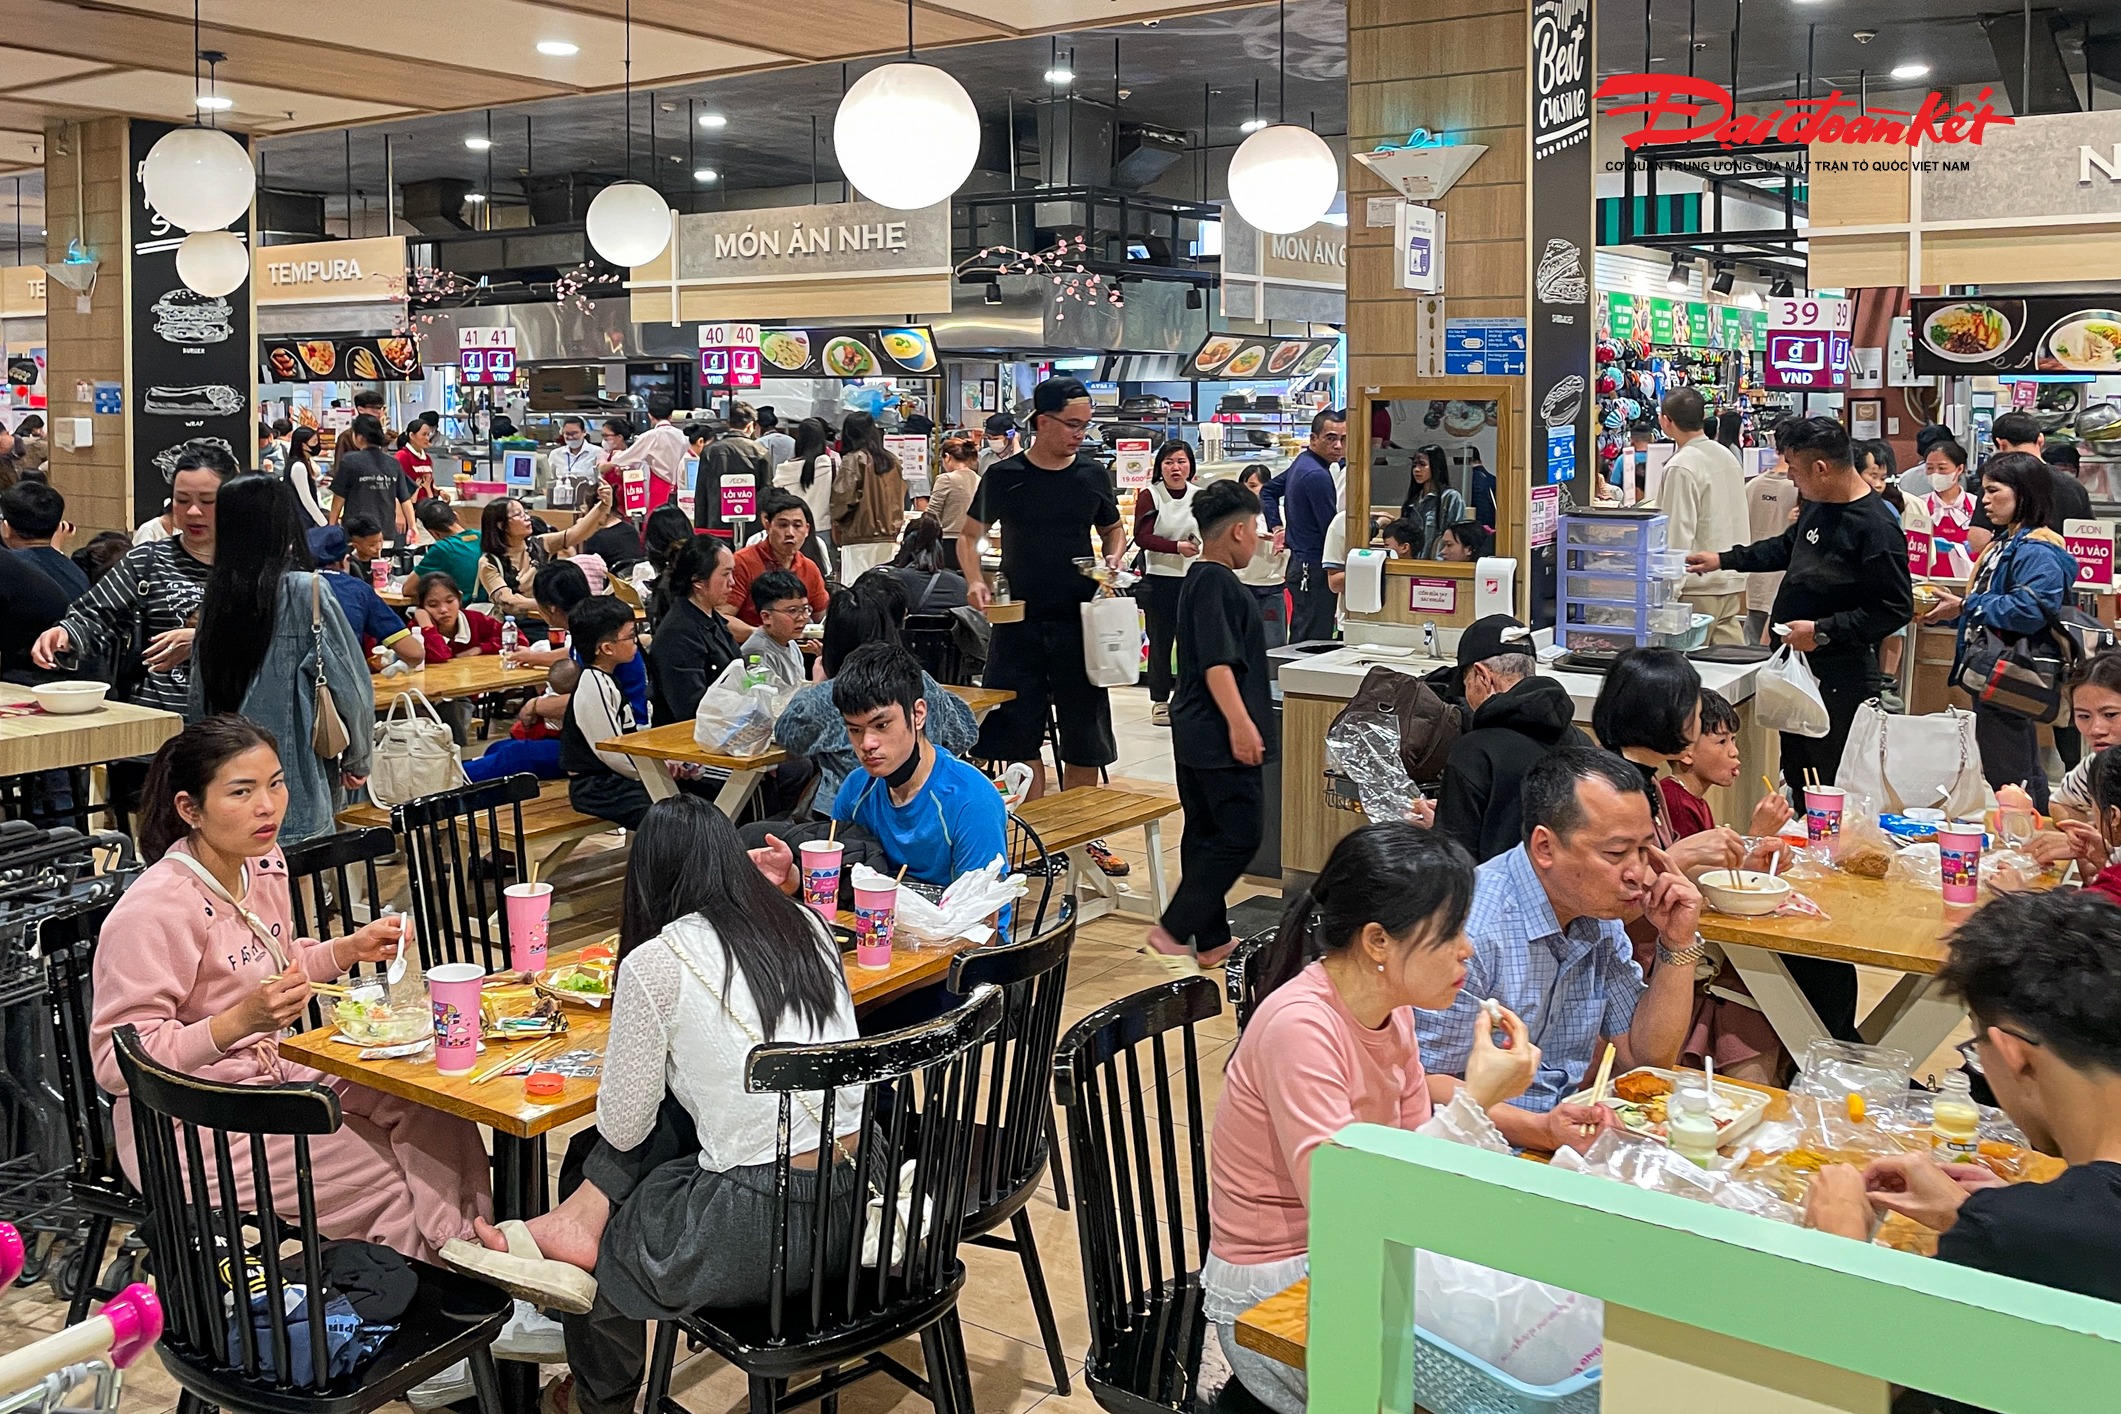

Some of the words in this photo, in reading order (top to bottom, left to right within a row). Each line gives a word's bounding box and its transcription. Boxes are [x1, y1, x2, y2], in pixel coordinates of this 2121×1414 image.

[1533, 16, 1586, 95] Best
[1539, 88, 1586, 129] cuisine
[714, 224, 781, 259] MÓN
[787, 221, 831, 254] ĂN
[838, 221, 907, 254] NHẸ
[267, 258, 363, 286] TEMPURA
[27, 280, 46, 299] TE
[1782, 302, 1819, 326] 39
[1836, 303, 1848, 327] 39
[464, 330, 478, 345] 41
[491, 330, 507, 345] 41
[706, 327, 724, 344] 40
[736, 327, 754, 343] 40
[1780, 371, 1814, 385] VND
[2086, 544, 2110, 557] VÀO
